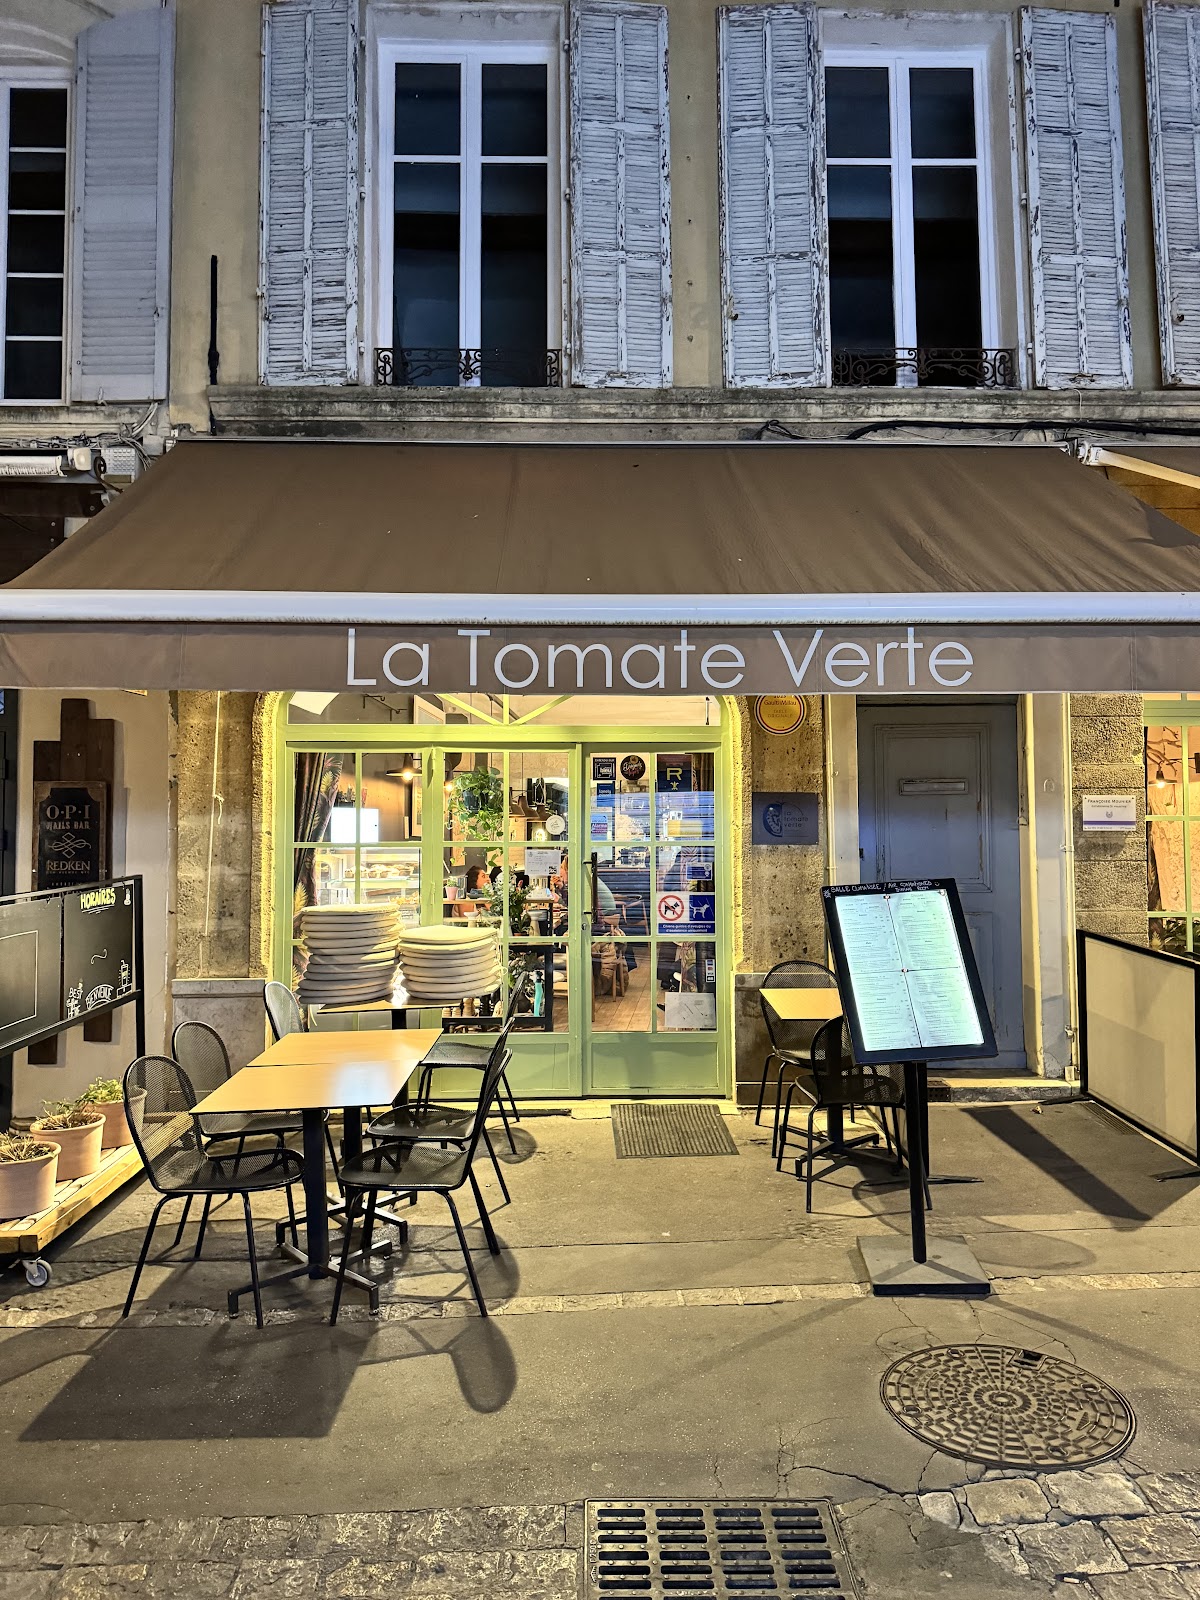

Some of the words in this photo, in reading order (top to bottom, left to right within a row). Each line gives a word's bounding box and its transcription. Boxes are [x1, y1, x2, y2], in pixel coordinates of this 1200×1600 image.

[347, 628, 429, 687] La
[458, 629, 746, 689] Tomate
[772, 627, 974, 687] Verte
[666, 768, 682, 781] R
[47, 860, 91, 871] REDKEN
